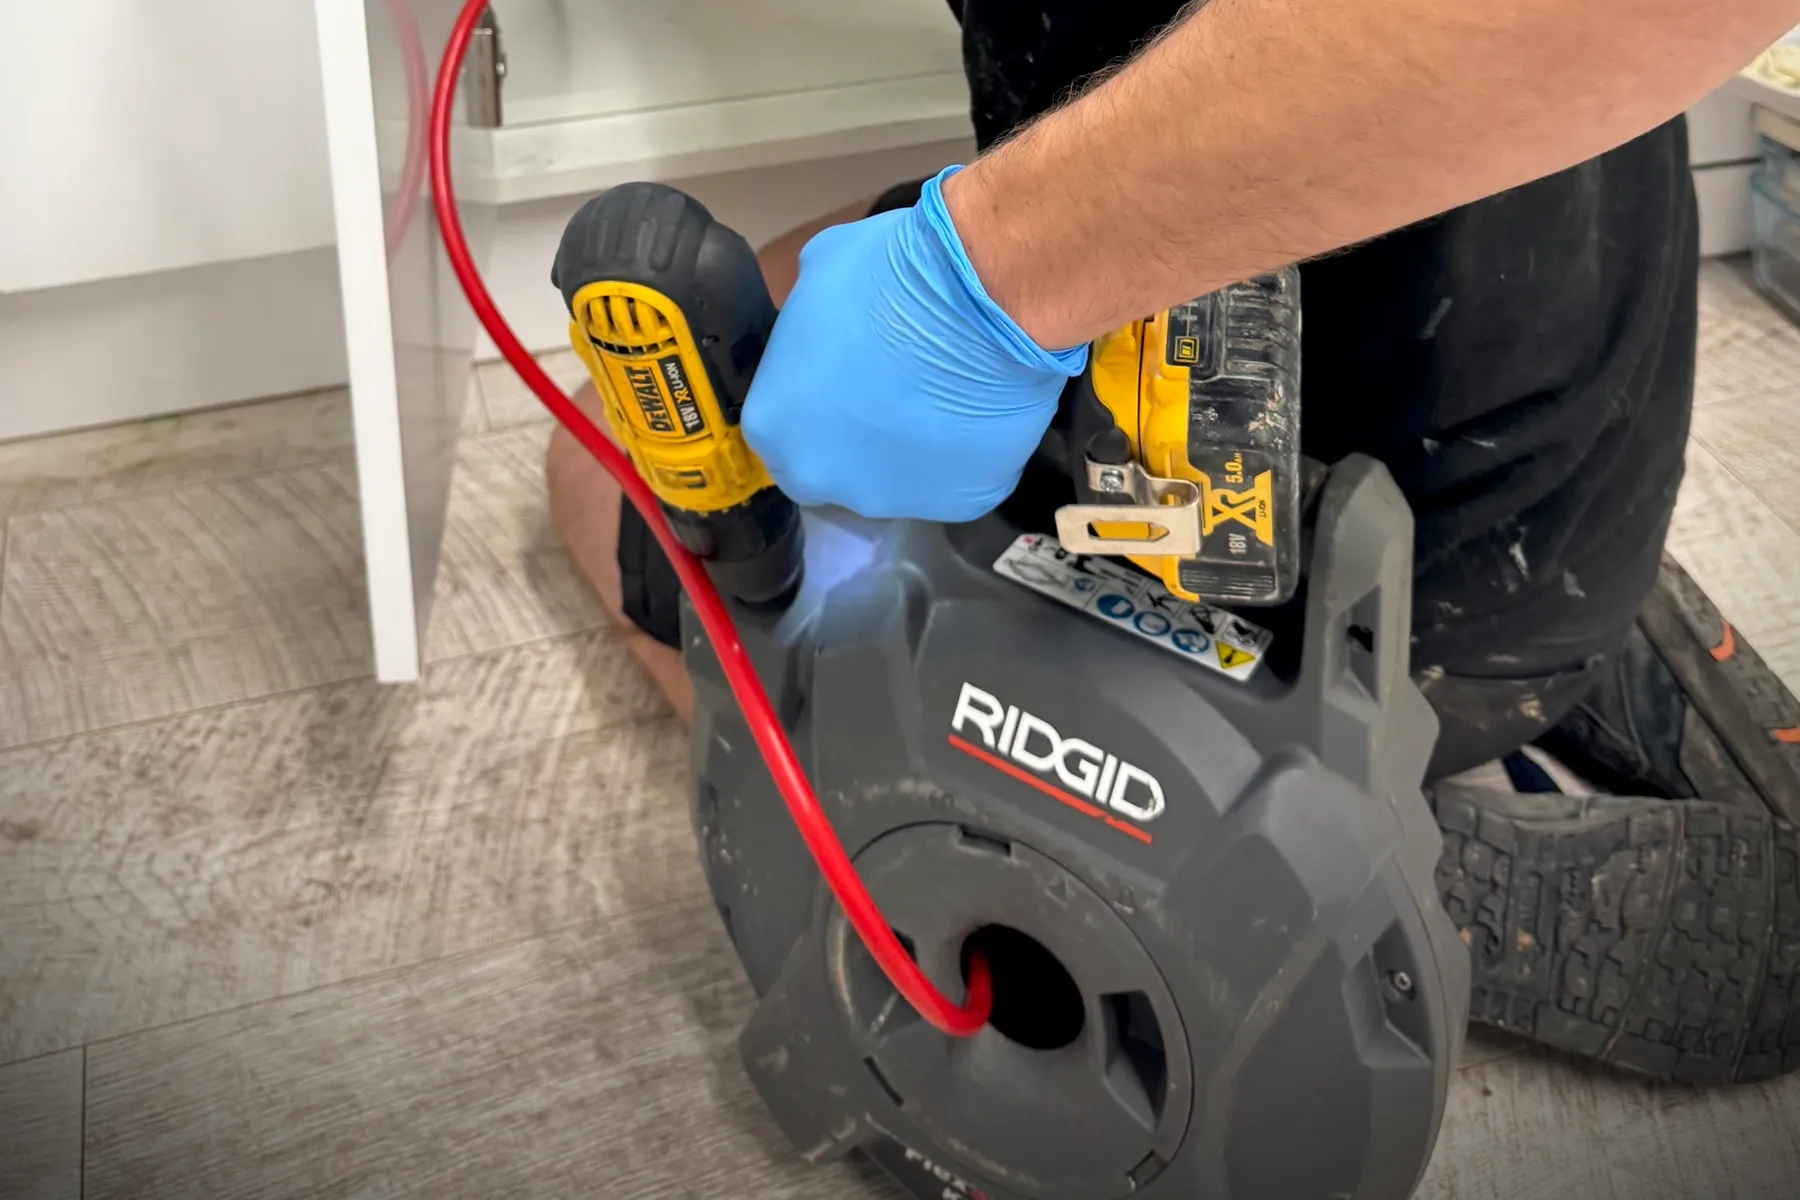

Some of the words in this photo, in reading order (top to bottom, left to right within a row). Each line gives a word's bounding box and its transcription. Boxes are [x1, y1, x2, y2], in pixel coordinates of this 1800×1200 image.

[680, 406, 700, 430] 18V
[1227, 532, 1248, 556] 18V
[951, 682, 1167, 823] RIDGID
